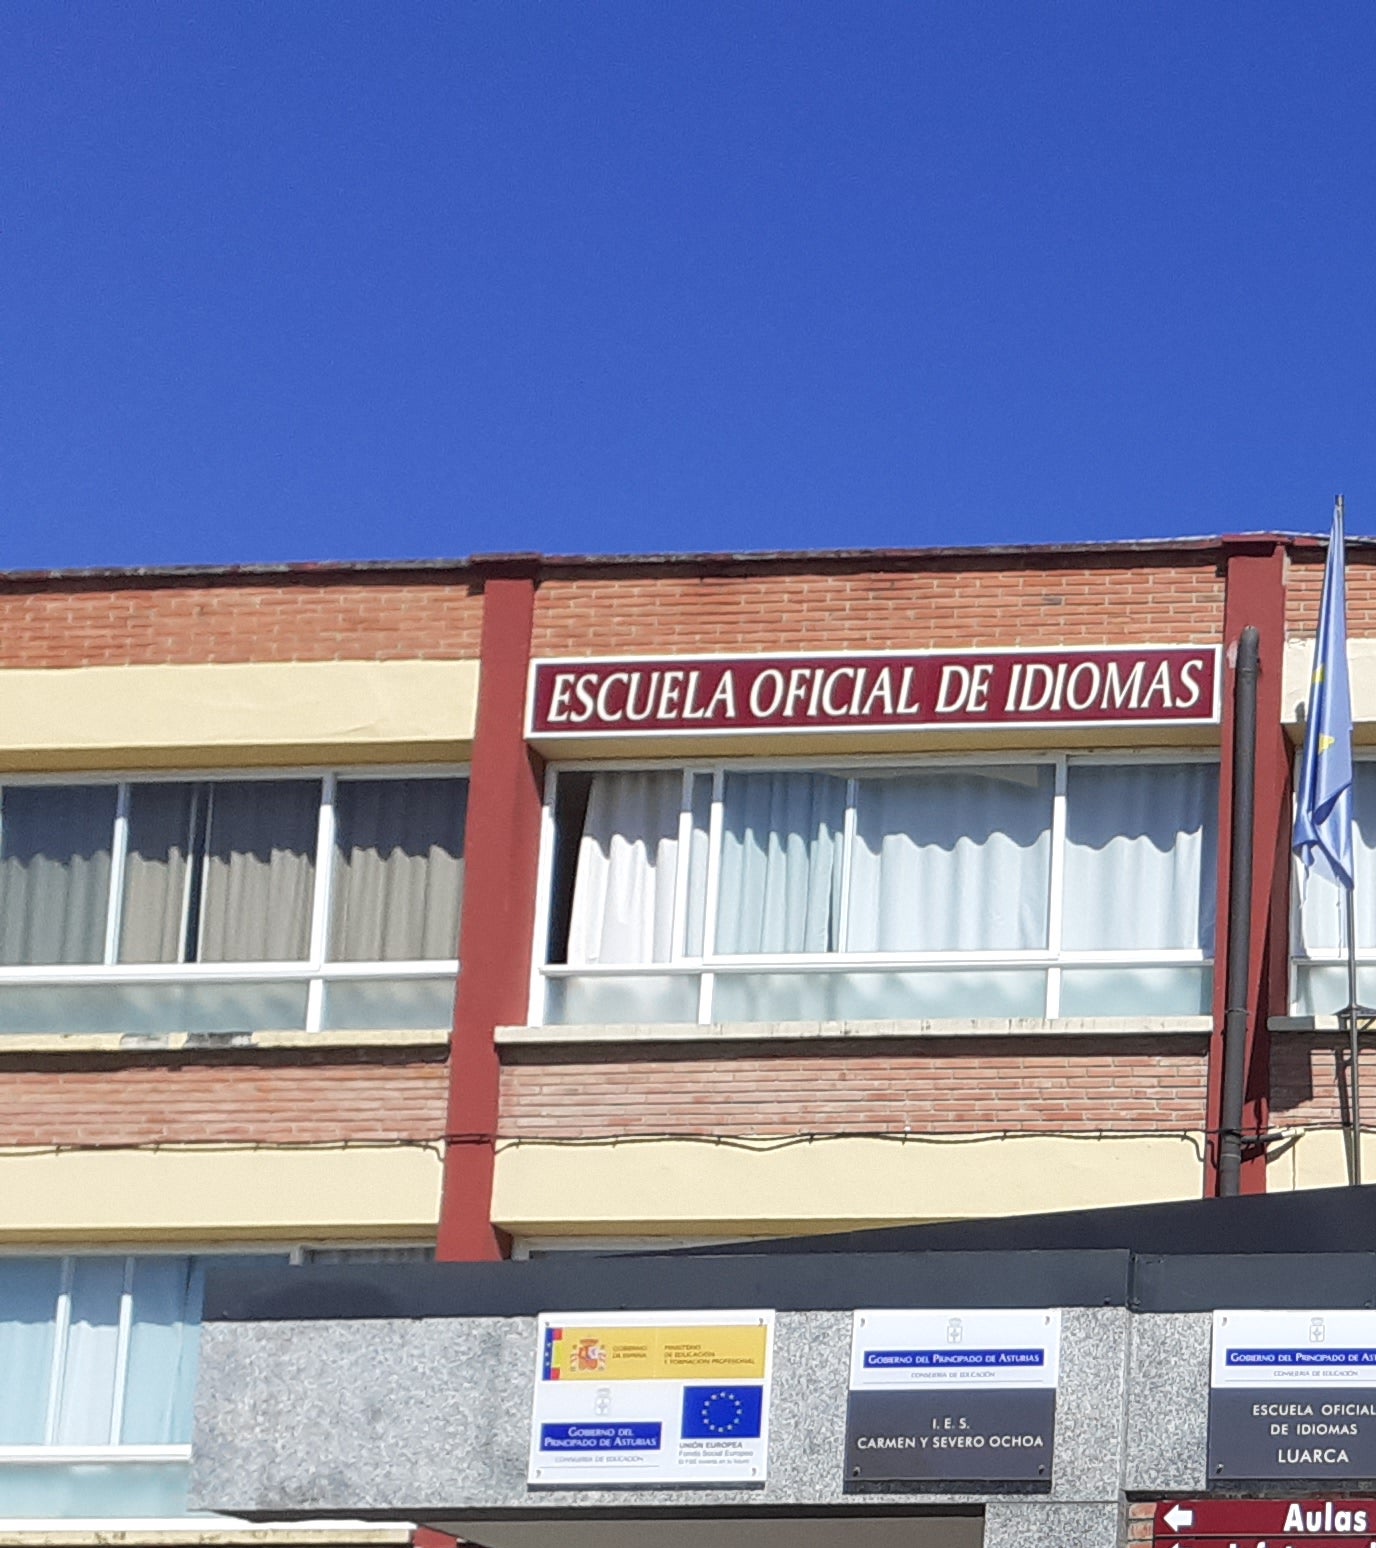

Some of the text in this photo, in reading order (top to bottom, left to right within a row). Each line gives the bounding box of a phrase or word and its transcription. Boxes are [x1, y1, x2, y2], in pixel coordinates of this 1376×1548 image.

[547, 658, 1205, 724] ESCUELA OFICIAL DE IDIOMAS
[869, 1355, 912, 1364] GOBIERNO
[933, 1354, 982, 1363] PRINCIPADO
[999, 1353, 1040, 1362] ASTURIAS
[1230, 1353, 1274, 1362] GOBIERNO
[1296, 1352, 1344, 1361] PRINCIPADO
[1252, 1404, 1376, 1416] ESCUELA OFICIAL
[932, 1418, 970, 1430] I. E. S.
[1270, 1424, 1358, 1435] DE IDIOMAS
[568, 1427, 633, 1437] GOBIERNO DEL
[544, 1437, 597, 1447] PRINCIPADO
[614, 1437, 656, 1447] ASTURIAS
[857, 1435, 1043, 1449] CARMEN Y SEVERO OCHOA
[1278, 1449, 1349, 1463] LUARCA
[1283, 1502, 1367, 1532] Aulas
